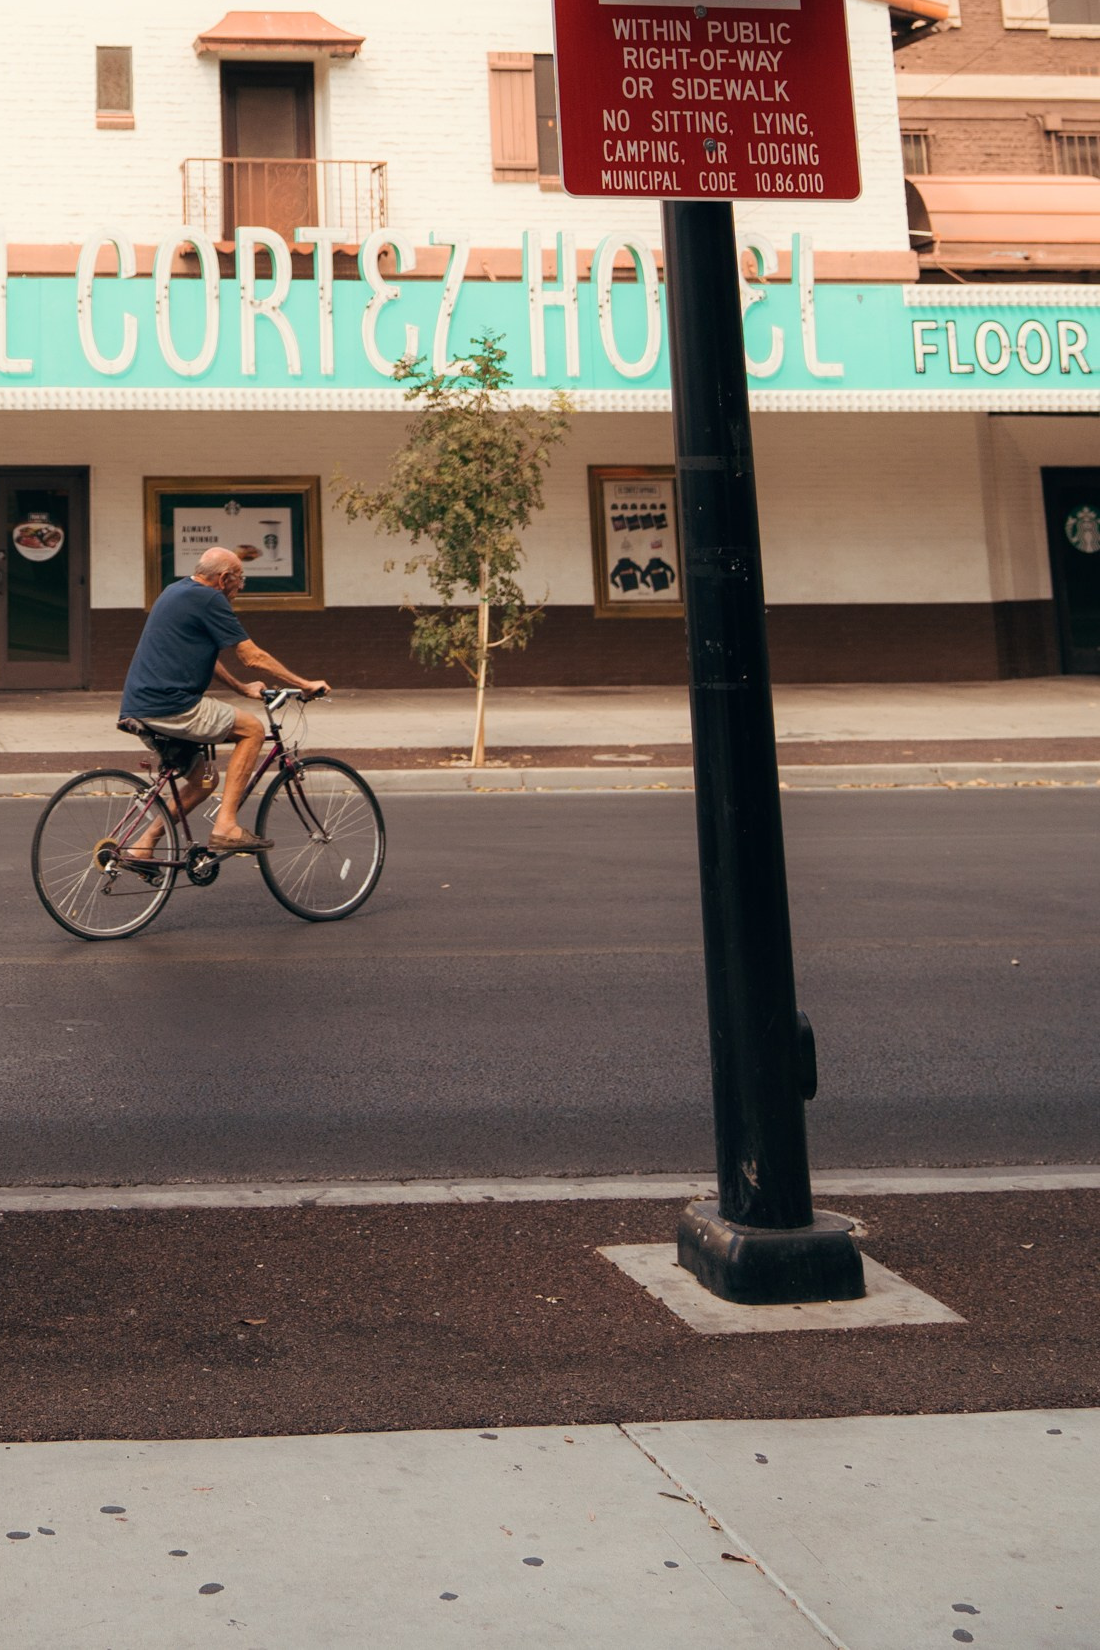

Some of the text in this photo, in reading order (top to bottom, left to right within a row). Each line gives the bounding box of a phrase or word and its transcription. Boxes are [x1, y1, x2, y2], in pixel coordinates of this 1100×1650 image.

[612, 18, 792, 45] WITHIN PUBLIC
[623, 47, 783, 73] RIGHT-OF-WAY
[622, 76, 790, 102] OR SIDEWALK
[602, 109, 814, 138] NO SITTING, LYING,
[603, 139, 686, 165] CAMPING,
[748, 142, 820, 166] LODGING
[601, 169, 824, 194] MUNICIPAL CODE 10.86.010
[76, 226, 477, 378] CORTEZ
[522, 230, 844, 378] HOEL
[911, 318, 1093, 375] FLOOR
[190, 535, 219, 543] WINNER
